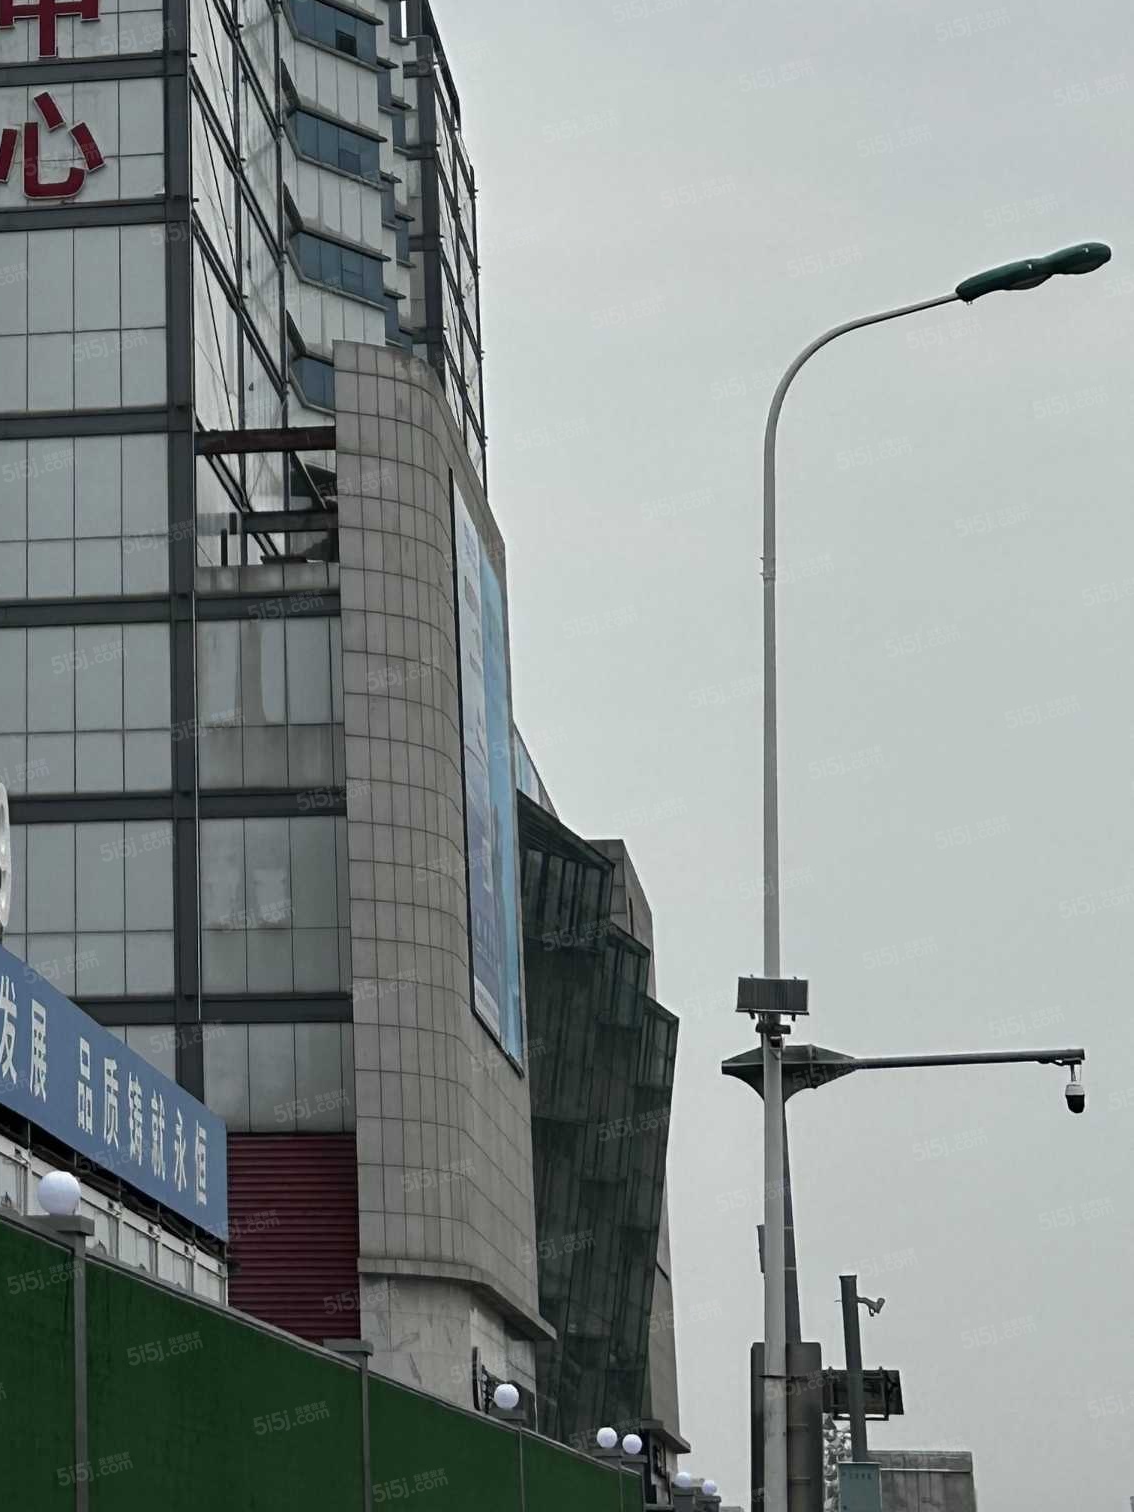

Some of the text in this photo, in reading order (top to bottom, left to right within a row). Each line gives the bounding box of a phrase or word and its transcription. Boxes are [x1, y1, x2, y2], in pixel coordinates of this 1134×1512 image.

[77, 1036, 208, 1207] 品质铸就永恒
